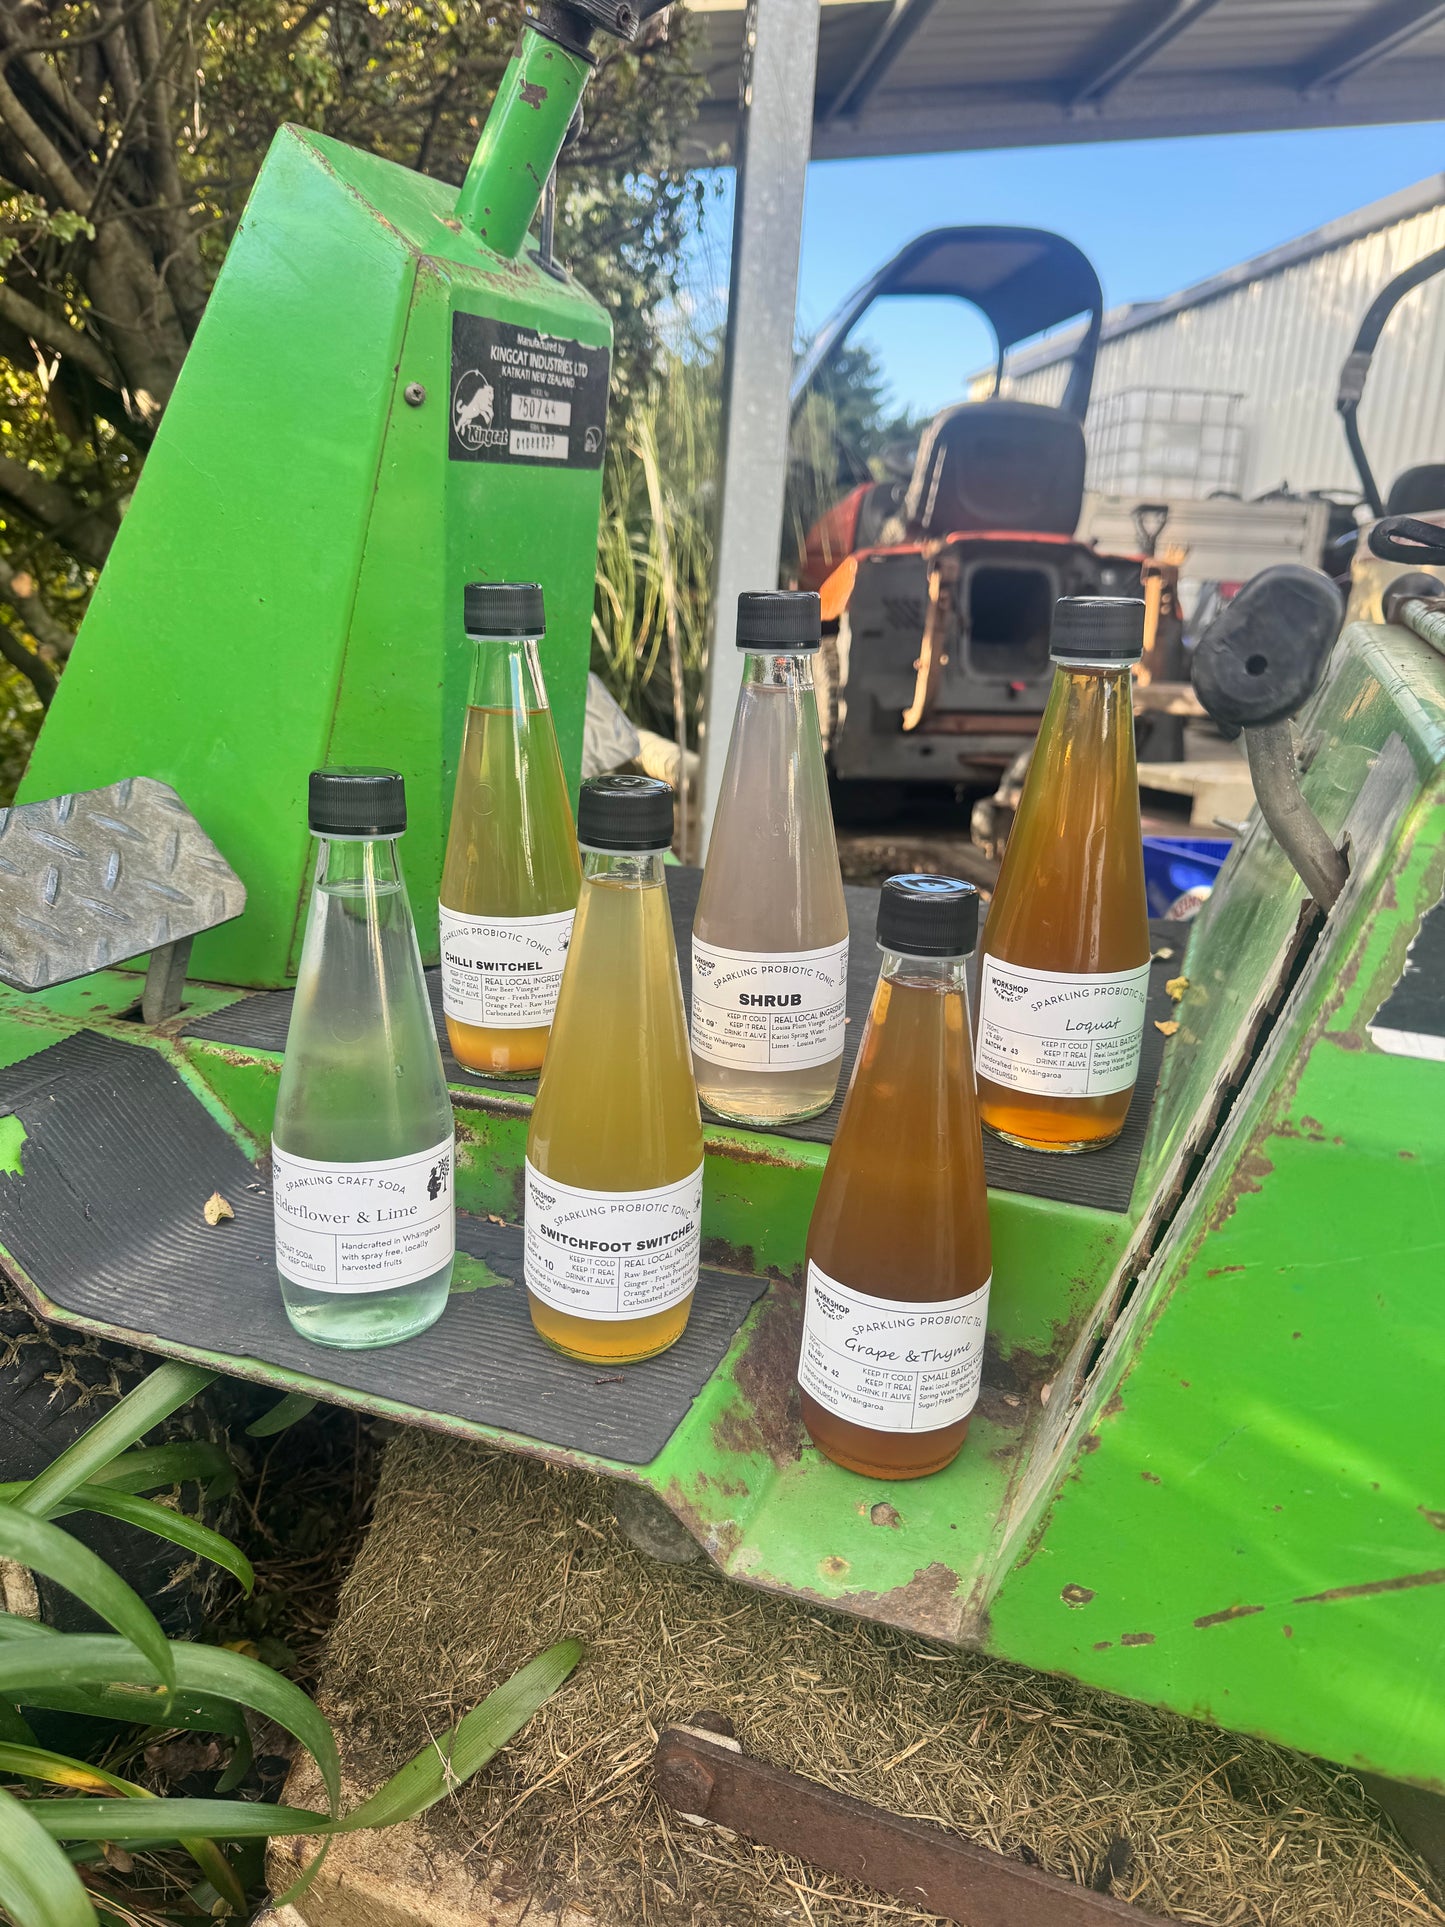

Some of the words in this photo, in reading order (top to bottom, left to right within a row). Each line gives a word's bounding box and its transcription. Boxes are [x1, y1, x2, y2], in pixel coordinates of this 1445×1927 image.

[558, 346, 566, 357] by
[490, 345, 528, 366] KINGCAT
[530, 353, 573, 375] INDUSTRIES
[574, 363, 588, 378] LTD
[501, 365, 530, 380] KATIKATI
[531, 370, 547, 383] NEW
[468, 425, 508, 447] Kingcat
[472, 927, 523, 943] PROBIOTIC
[525, 938, 552, 956] TONIC
[445, 952, 472, 968] CHILLI
[476, 961, 543, 971] SWITCHEL
[694, 954, 716, 969] WORKSHOP
[464, 974, 478, 982] COLD
[714, 967, 758, 988] SPARKLING
[762, 966, 813, 977] PROBIOTIC
[815, 971, 835, 987] TONIC
[467, 982, 479, 990] REAL
[992, 977, 1029, 994] WORKSHOP
[485, 994, 505, 1002] Ginger
[531, 991, 553, 999] Pressed
[739, 993, 802, 1007] SHRUB
[1031, 990, 1090, 1012] SPARKLING
[1094, 987, 1139, 999] PROBIOTIC
[485, 1002, 508, 1010] Orange
[795, 1014, 818, 1022] LOCAL
[1065, 1017, 1122, 1034] Loquat
[724, 1028, 741, 1036] DRINK
[985, 1039, 1000, 1050] BATCH
[1068, 1041, 1088, 1049] COLD
[1096, 1041, 1118, 1050] SMALL
[982, 1052, 1012, 1070] Handcrafted
[286, 1176, 333, 1192] SPARKLING
[338, 1176, 374, 1187] CRAFT
[377, 1180, 406, 1195] SODA
[529, 1181, 557, 1205] WORKSHOP
[275, 1191, 350, 1224] Elderflower
[356, 1212, 370, 1224] &
[377, 1205, 418, 1222] Lime
[554, 1206, 606, 1226] SPARKLING
[610, 1203, 669, 1213] PROBIOTIC
[671, 1205, 691, 1220] TONIC
[540, 1223, 631, 1252] SWITCHFOOT
[636, 1220, 695, 1251] SWITCHEL
[341, 1239, 392, 1250] Handcrafted
[361, 1253, 383, 1262] spray
[385, 1249, 403, 1257] free,
[405, 1240, 429, 1253] locally
[296, 1249, 313, 1260] SODA
[569, 1255, 585, 1263] KEEP
[624, 1259, 645, 1267] REAL
[648, 1251, 672, 1264] LOCAL
[288, 1255, 300, 1264] KEEP
[301, 1261, 326, 1272] CHILLED
[341, 1263, 382, 1271] harvested
[384, 1258, 402, 1268] fruits
[544, 1259, 554, 1271] 10
[572, 1264, 588, 1273] KEEP
[660, 1260, 680, 1270] Vinegar
[566, 1271, 584, 1282] DRINK
[624, 1280, 648, 1288] Ginger
[656, 1272, 671, 1282] Fresh
[623, 1289, 650, 1297] Orange
[652, 1283, 665, 1292] Peel
[623, 1293, 662, 1306] Carbonated
[814, 1286, 850, 1314] WORKSHOP
[852, 1318, 915, 1336] SPARKLING
[920, 1316, 972, 1327] PROBIOTIC
[845, 1337, 900, 1361] Grape
[808, 1349, 822, 1366] BATCH
[862, 1368, 880, 1377] KEEP
[883, 1370, 889, 1378] IT
[922, 1372, 948, 1383] SMALL
[950, 1360, 972, 1377] BATCH
[833, 1386, 839, 1395] in
[865, 1378, 883, 1386] KEEP
[885, 1381, 891, 1389] IT
[893, 1382, 912, 1391] REAL
[856, 1385, 879, 1396] DRINK
[881, 1390, 888, 1398] IT
[890, 1392, 911, 1400] ALIVE
[939, 1396, 954, 1405] Fresh
